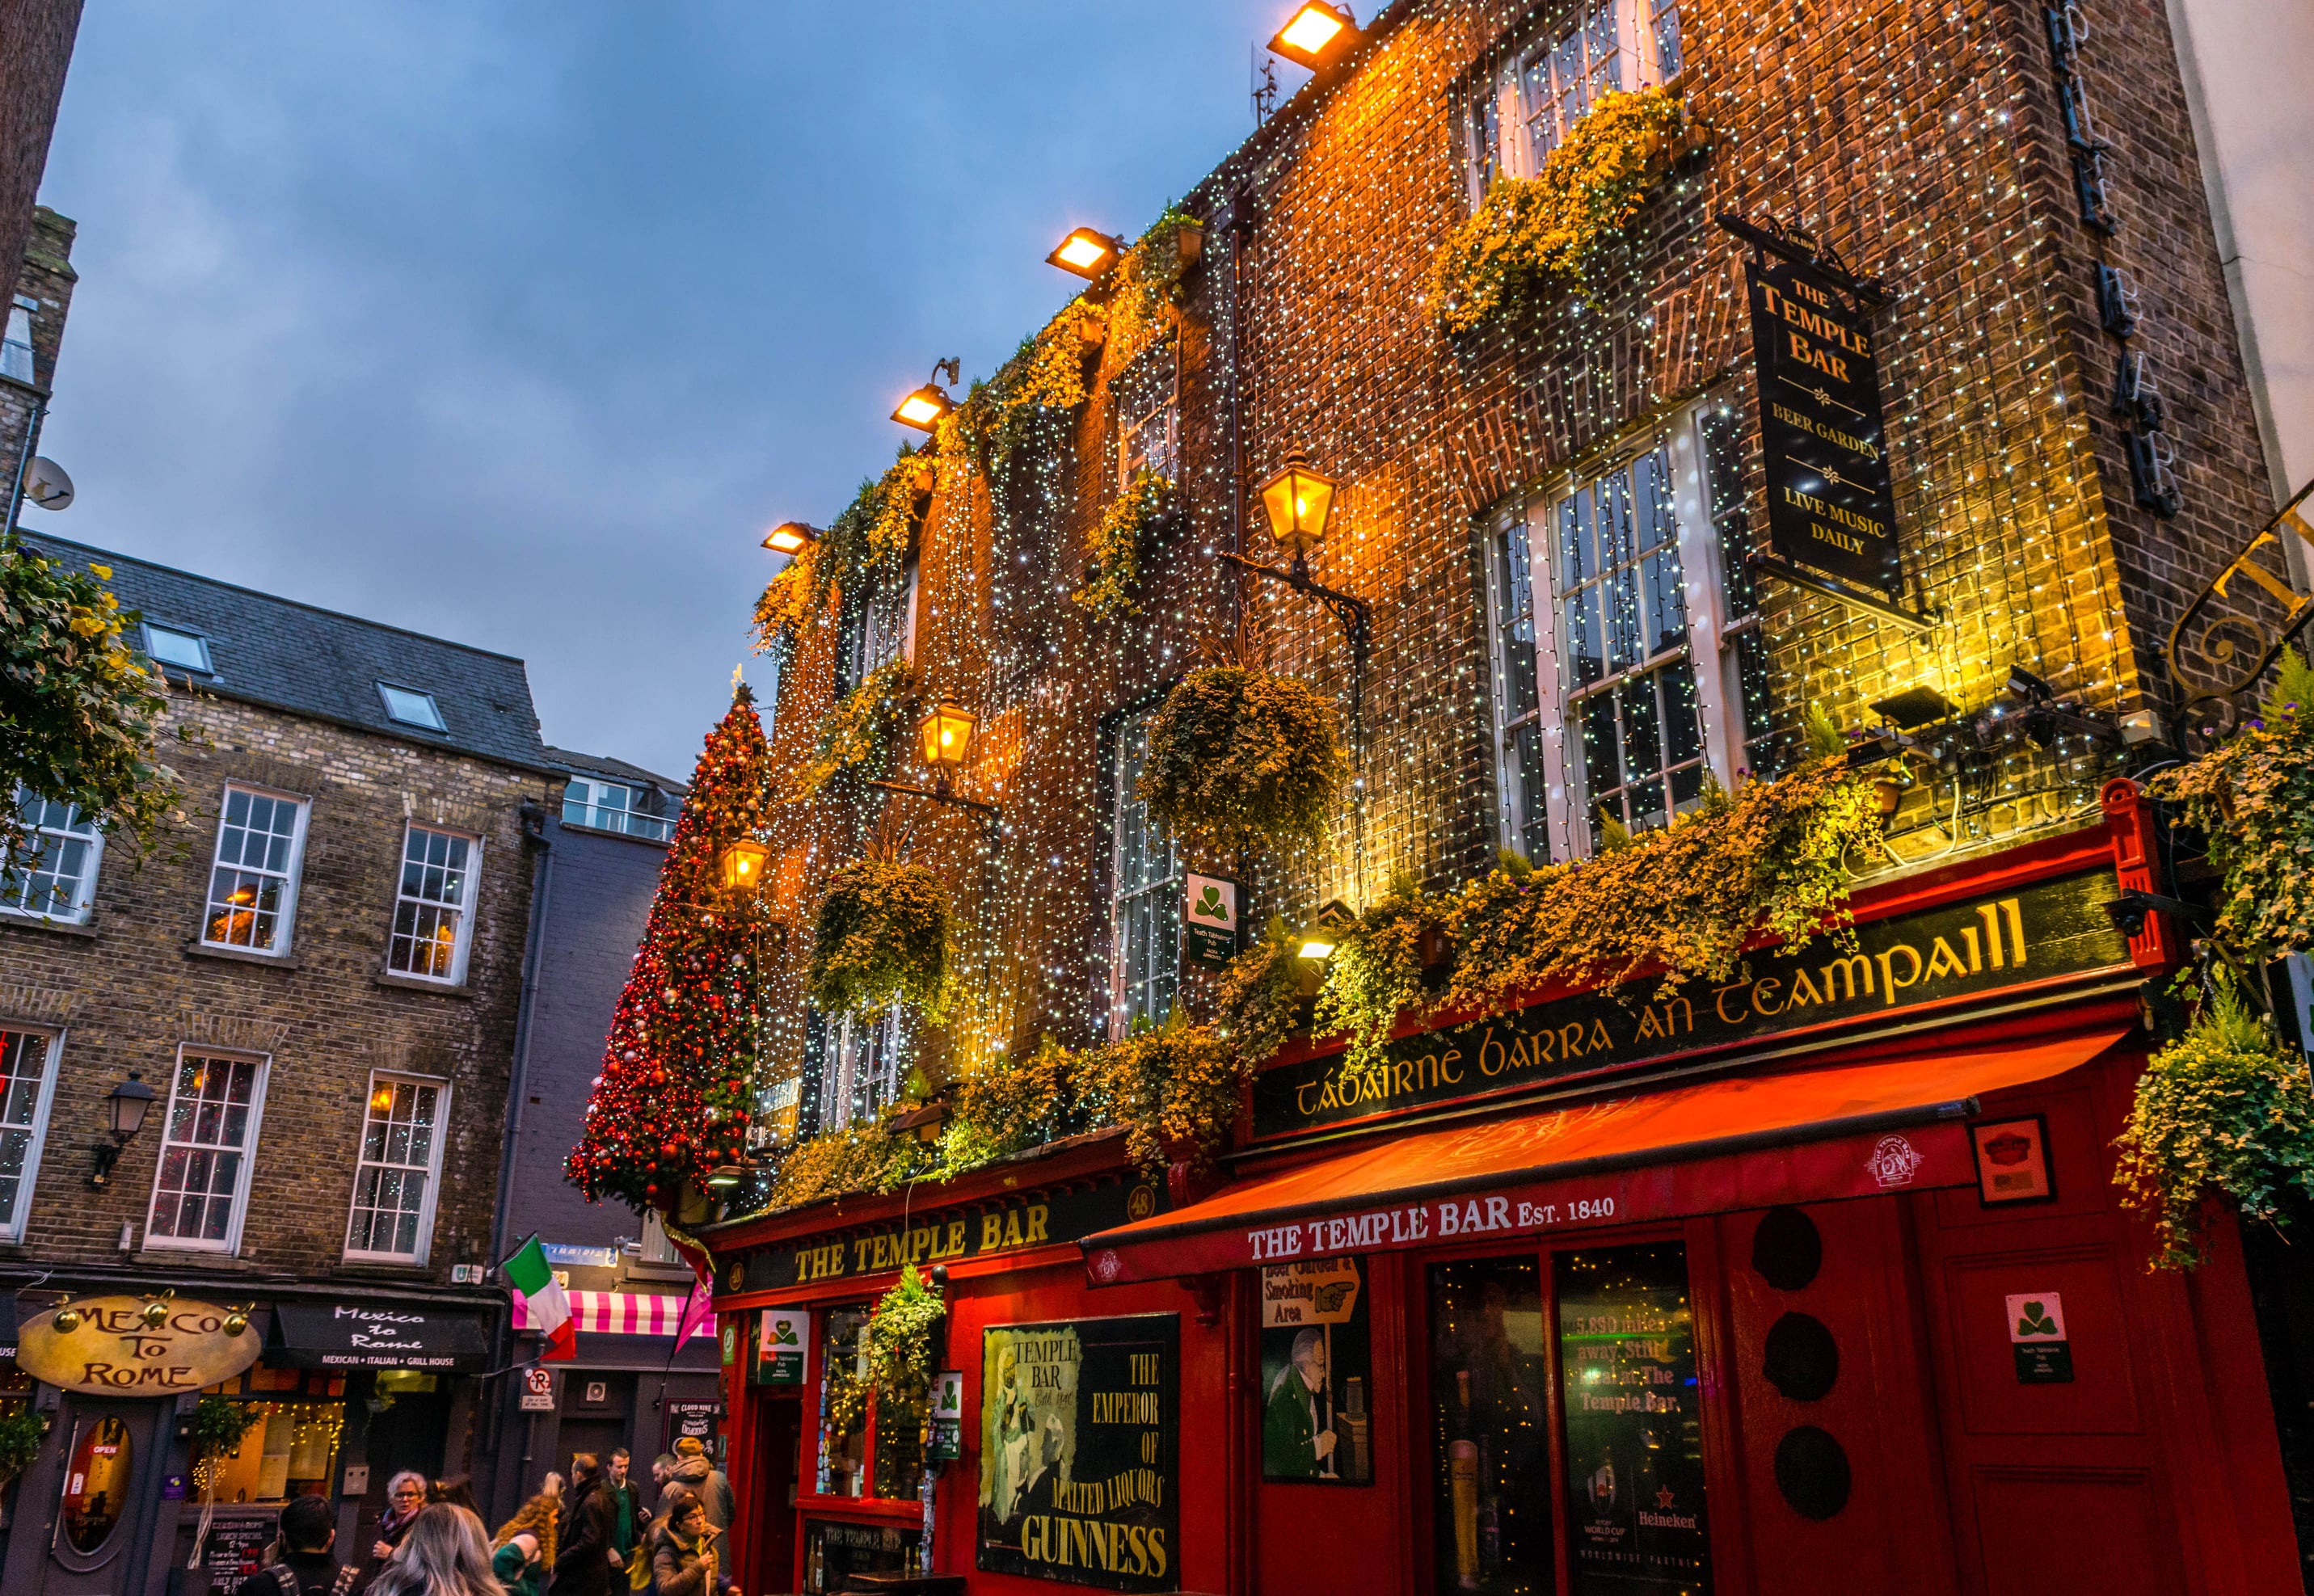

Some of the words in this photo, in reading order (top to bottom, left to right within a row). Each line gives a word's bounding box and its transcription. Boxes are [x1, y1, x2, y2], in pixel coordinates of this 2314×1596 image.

[1791, 277, 1830, 309] THE
[1756, 280, 1871, 359] TEMPLE
[1787, 330, 1851, 383] BAR
[1772, 402, 1814, 434] BEER
[1815, 422, 1880, 461] GARDEN
[1783, 486, 1827, 517] LIVE
[1829, 507, 1887, 539] MUSIC
[1810, 522, 1866, 555] DAILY
[1207, 938, 1217, 946] Pub
[1131, 1192, 1148, 1216] 48
[1248, 1225, 1302, 1261] THE
[1309, 1206, 1429, 1253] TEMPLE
[1437, 1195, 1512, 1236] BAR
[1567, 1196, 1615, 1221] 1840
[795, 1243, 845, 1282] THE
[854, 1220, 967, 1274] TEMPLE
[979, 1204, 1049, 1252] BAR
[1265, 1278, 1314, 1303] Smoking
[75, 1307, 221, 1335] MEXCO
[334, 1305, 425, 1324] Mexico
[1274, 1303, 1303, 1323] Area
[350, 1334, 424, 1350] Rome
[369, 1324, 398, 1336] to
[322, 1354, 359, 1364] MEXICAN
[367, 1355, 398, 1365] ITALIAN
[407, 1357, 428, 1366] GRILL
[429, 1358, 454, 1366] HOUSE
[1014, 1338, 1077, 1364] TEMPLE
[1577, 1345, 1622, 1363] away.
[1625, 1340, 1660, 1358] Still
[78, 1362, 198, 1389] ROME
[1031, 1365, 1061, 1390] BAR
[1129, 1354, 1160, 1386] THE
[1641, 1366, 1675, 1384] The
[699, 1404, 712, 1413] NINE
[1092, 1392, 1160, 1425] EMPEROR
[1580, 1392, 1642, 1415] Temple
[93, 1446, 117, 1454] OPEN
[1141, 1431, 1160, 1464] OF
[1051, 1476, 1105, 1515] MALTED
[1107, 1468, 1165, 1511] LIQUORS
[1584, 1526, 1611, 1535] WORLD
[1638, 1510, 1697, 1529] Heineken
[1021, 1514, 1168, 1578] GUINNESS
[1650, 1555, 1696, 1569] PARTNE
